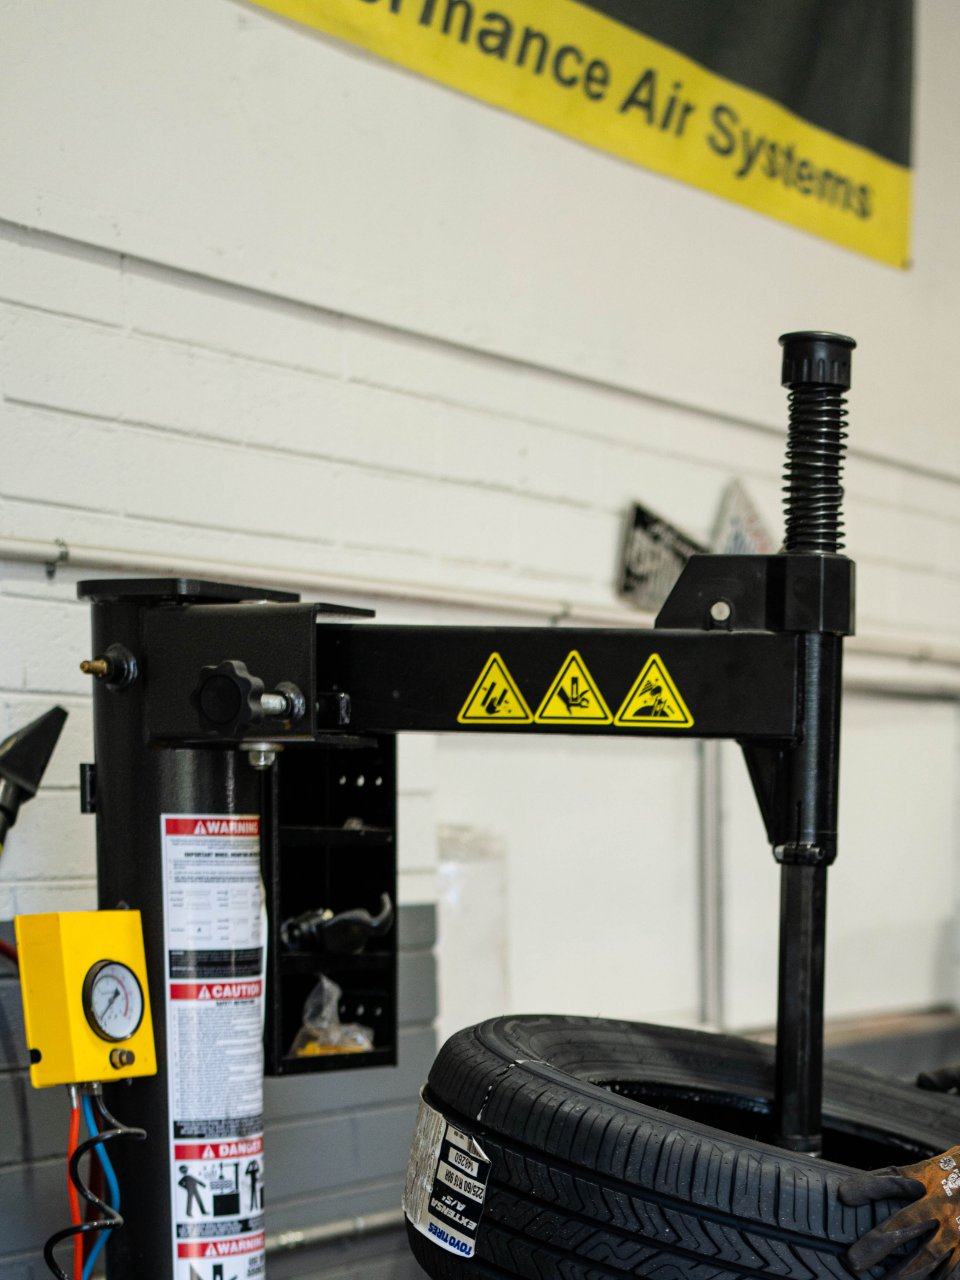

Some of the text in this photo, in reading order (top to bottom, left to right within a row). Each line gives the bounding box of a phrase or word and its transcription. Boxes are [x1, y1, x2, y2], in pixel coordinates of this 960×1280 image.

[358, 0, 874, 221] mance Air Systems
[430, 1197, 478, 1231] EXTENSA
[427, 1221, 473, 1256] TOYO TIRES
